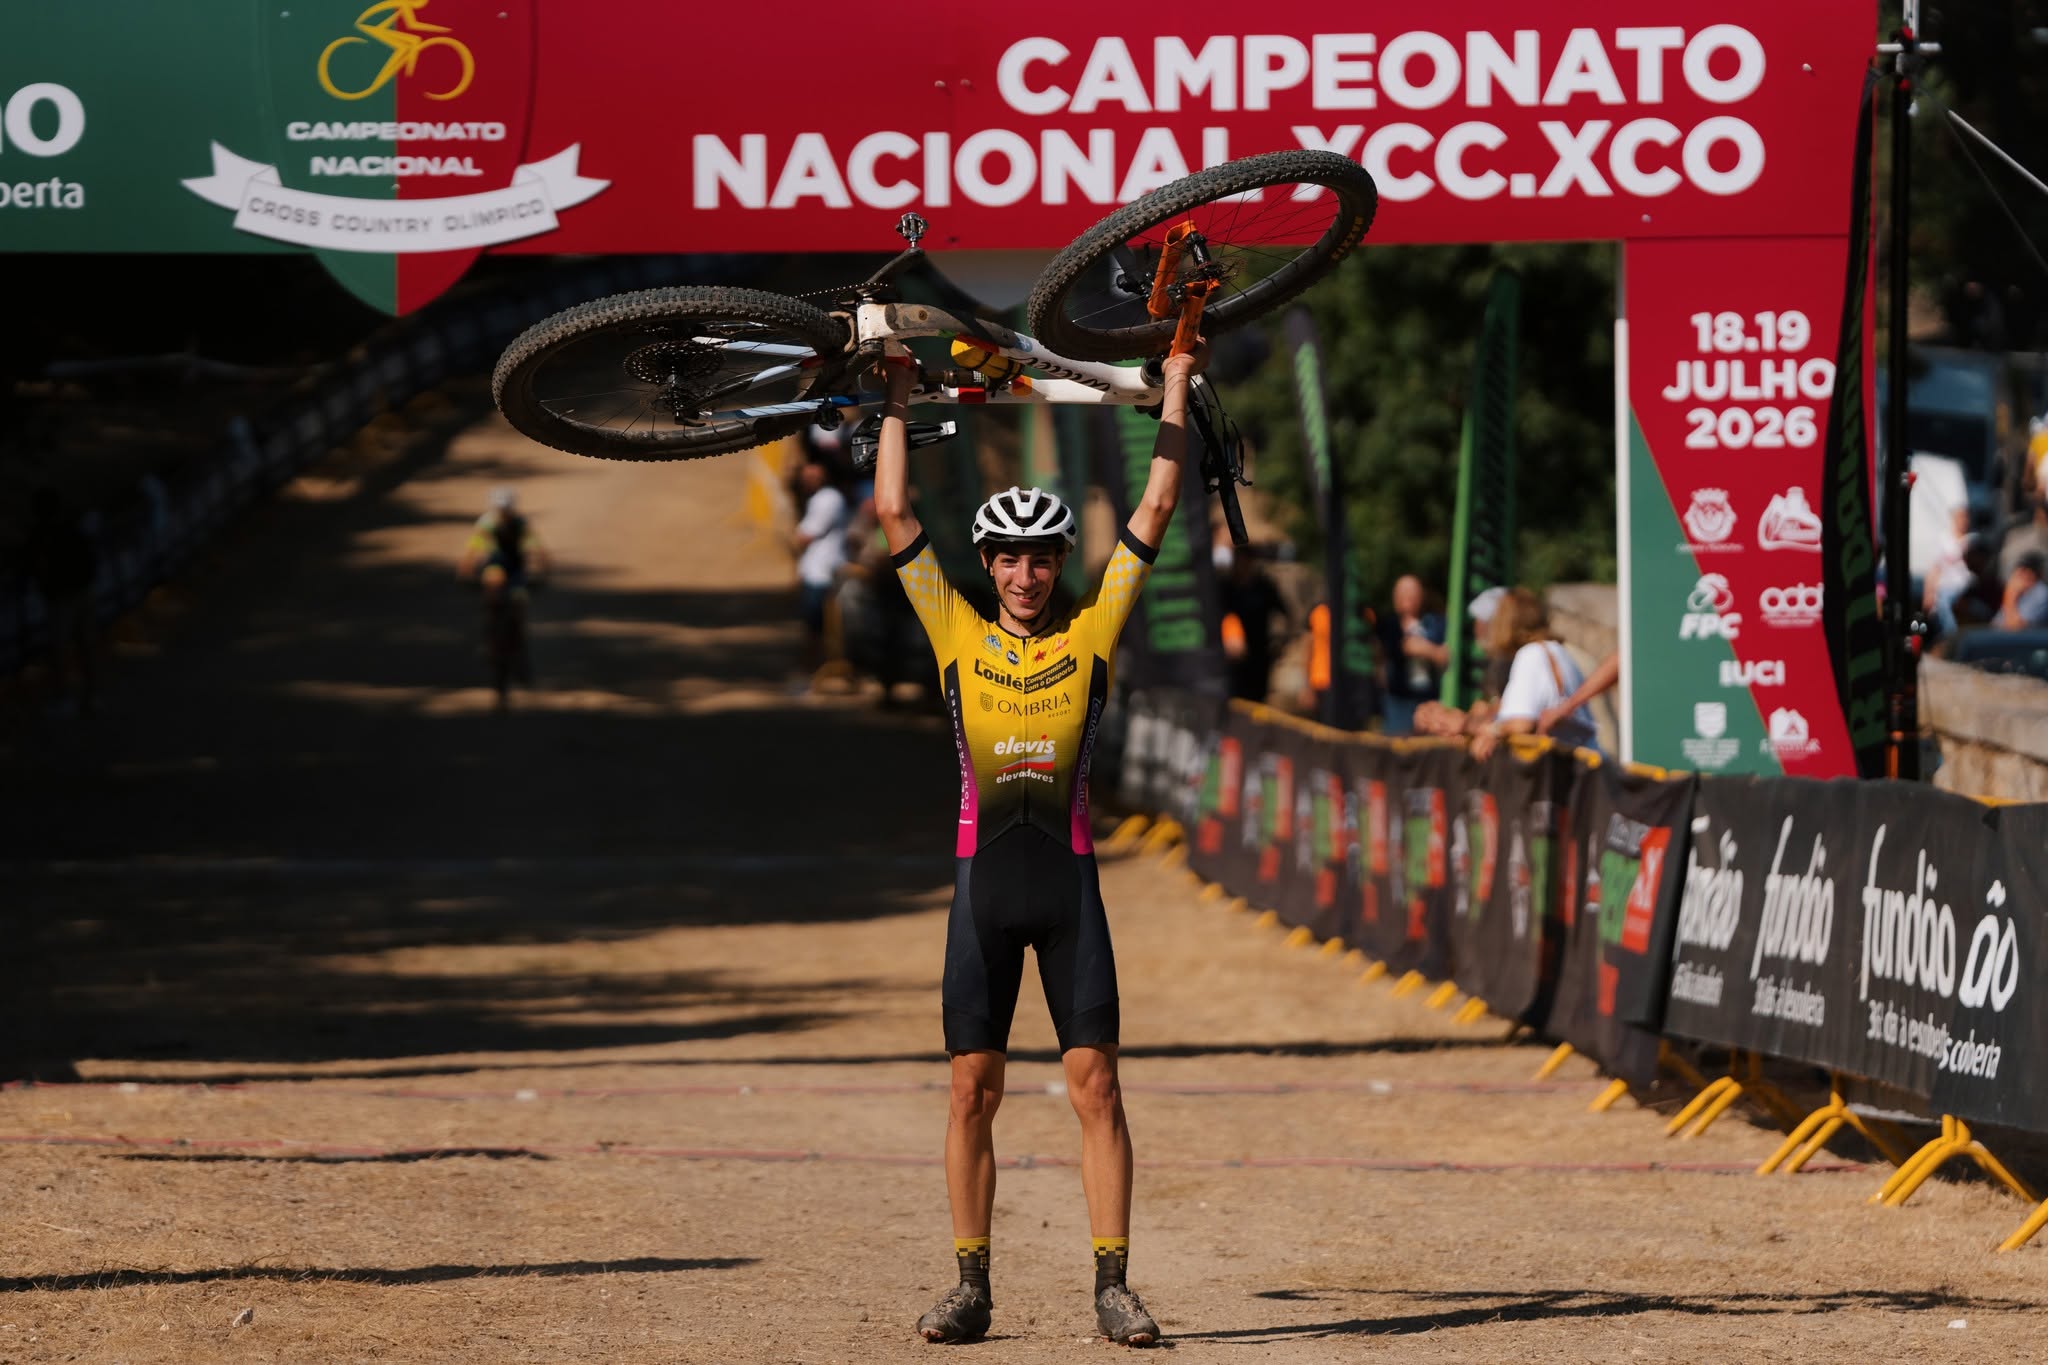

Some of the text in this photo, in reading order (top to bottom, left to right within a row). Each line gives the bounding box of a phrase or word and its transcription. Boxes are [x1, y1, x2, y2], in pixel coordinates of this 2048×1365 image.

[997, 24, 1767, 114] CAMPEONATO
[286, 121, 507, 141] CAMPEONATO
[309, 155, 485, 177] NACIONAL
[692, 115, 1766, 210] NACIONAL XCC.XCO
[248, 197, 321, 227] CROSS
[331, 213, 431, 234] COUNTRY
[1690, 309, 1811, 353] 18.19
[1662, 356, 1837, 402] JULHO
[1684, 405, 1818, 449] 2026
[1678, 612, 1743, 641] FPC
[974, 657, 1023, 691] Loulé
[1025, 659, 1068, 685] Compromisso
[1025, 682, 1039, 692] com
[1045, 664, 1075, 685] Desporto
[997, 691, 1071, 717] OMBRIA
[1047, 709, 1071, 719] RESORT
[993, 733, 1056, 755] elevis
[996, 768, 1055, 784] elevadores
